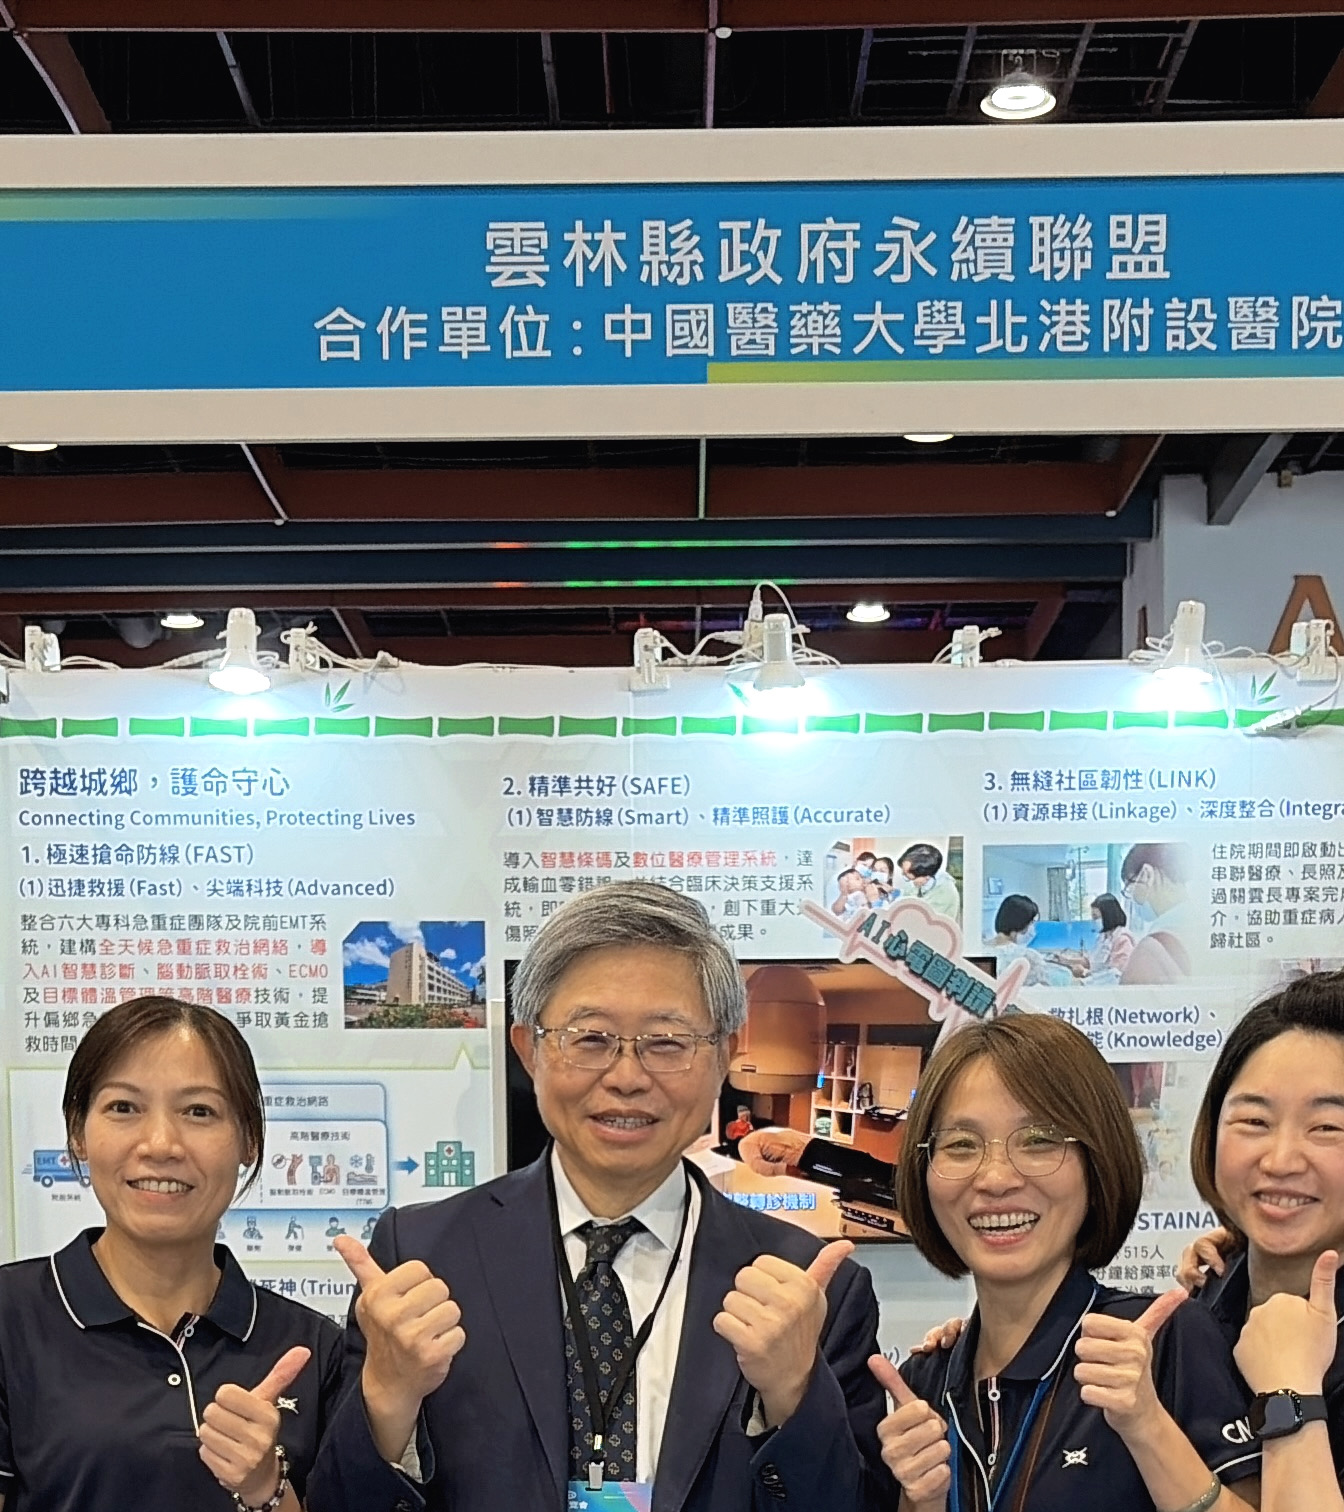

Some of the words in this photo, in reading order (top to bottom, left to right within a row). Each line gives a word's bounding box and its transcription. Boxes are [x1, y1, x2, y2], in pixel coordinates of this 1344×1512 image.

[485, 214, 1171, 288] 雲林縣政府永續聯盟
[19, 767, 290, 798] 跨越城鄉，護命守心
[503, 777, 523, 796] 2.
[528, 774, 692, 798] 精準共好(SAFE)
[984, 772, 1004, 792] 3.
[1010, 768, 1218, 793] 無縫社區韌性(LINK)
[19, 809, 126, 830] Connecting
[130, 809, 260, 830] Communities,
[267, 809, 363, 829] Protecting
[368, 809, 415, 827] Lives
[22, 846, 40, 864] 1.
[47, 843, 255, 867] 極速搶命防線(FAST)
[21, 913, 327, 931] 整合六大專科急重症團隊及院前EMT系
